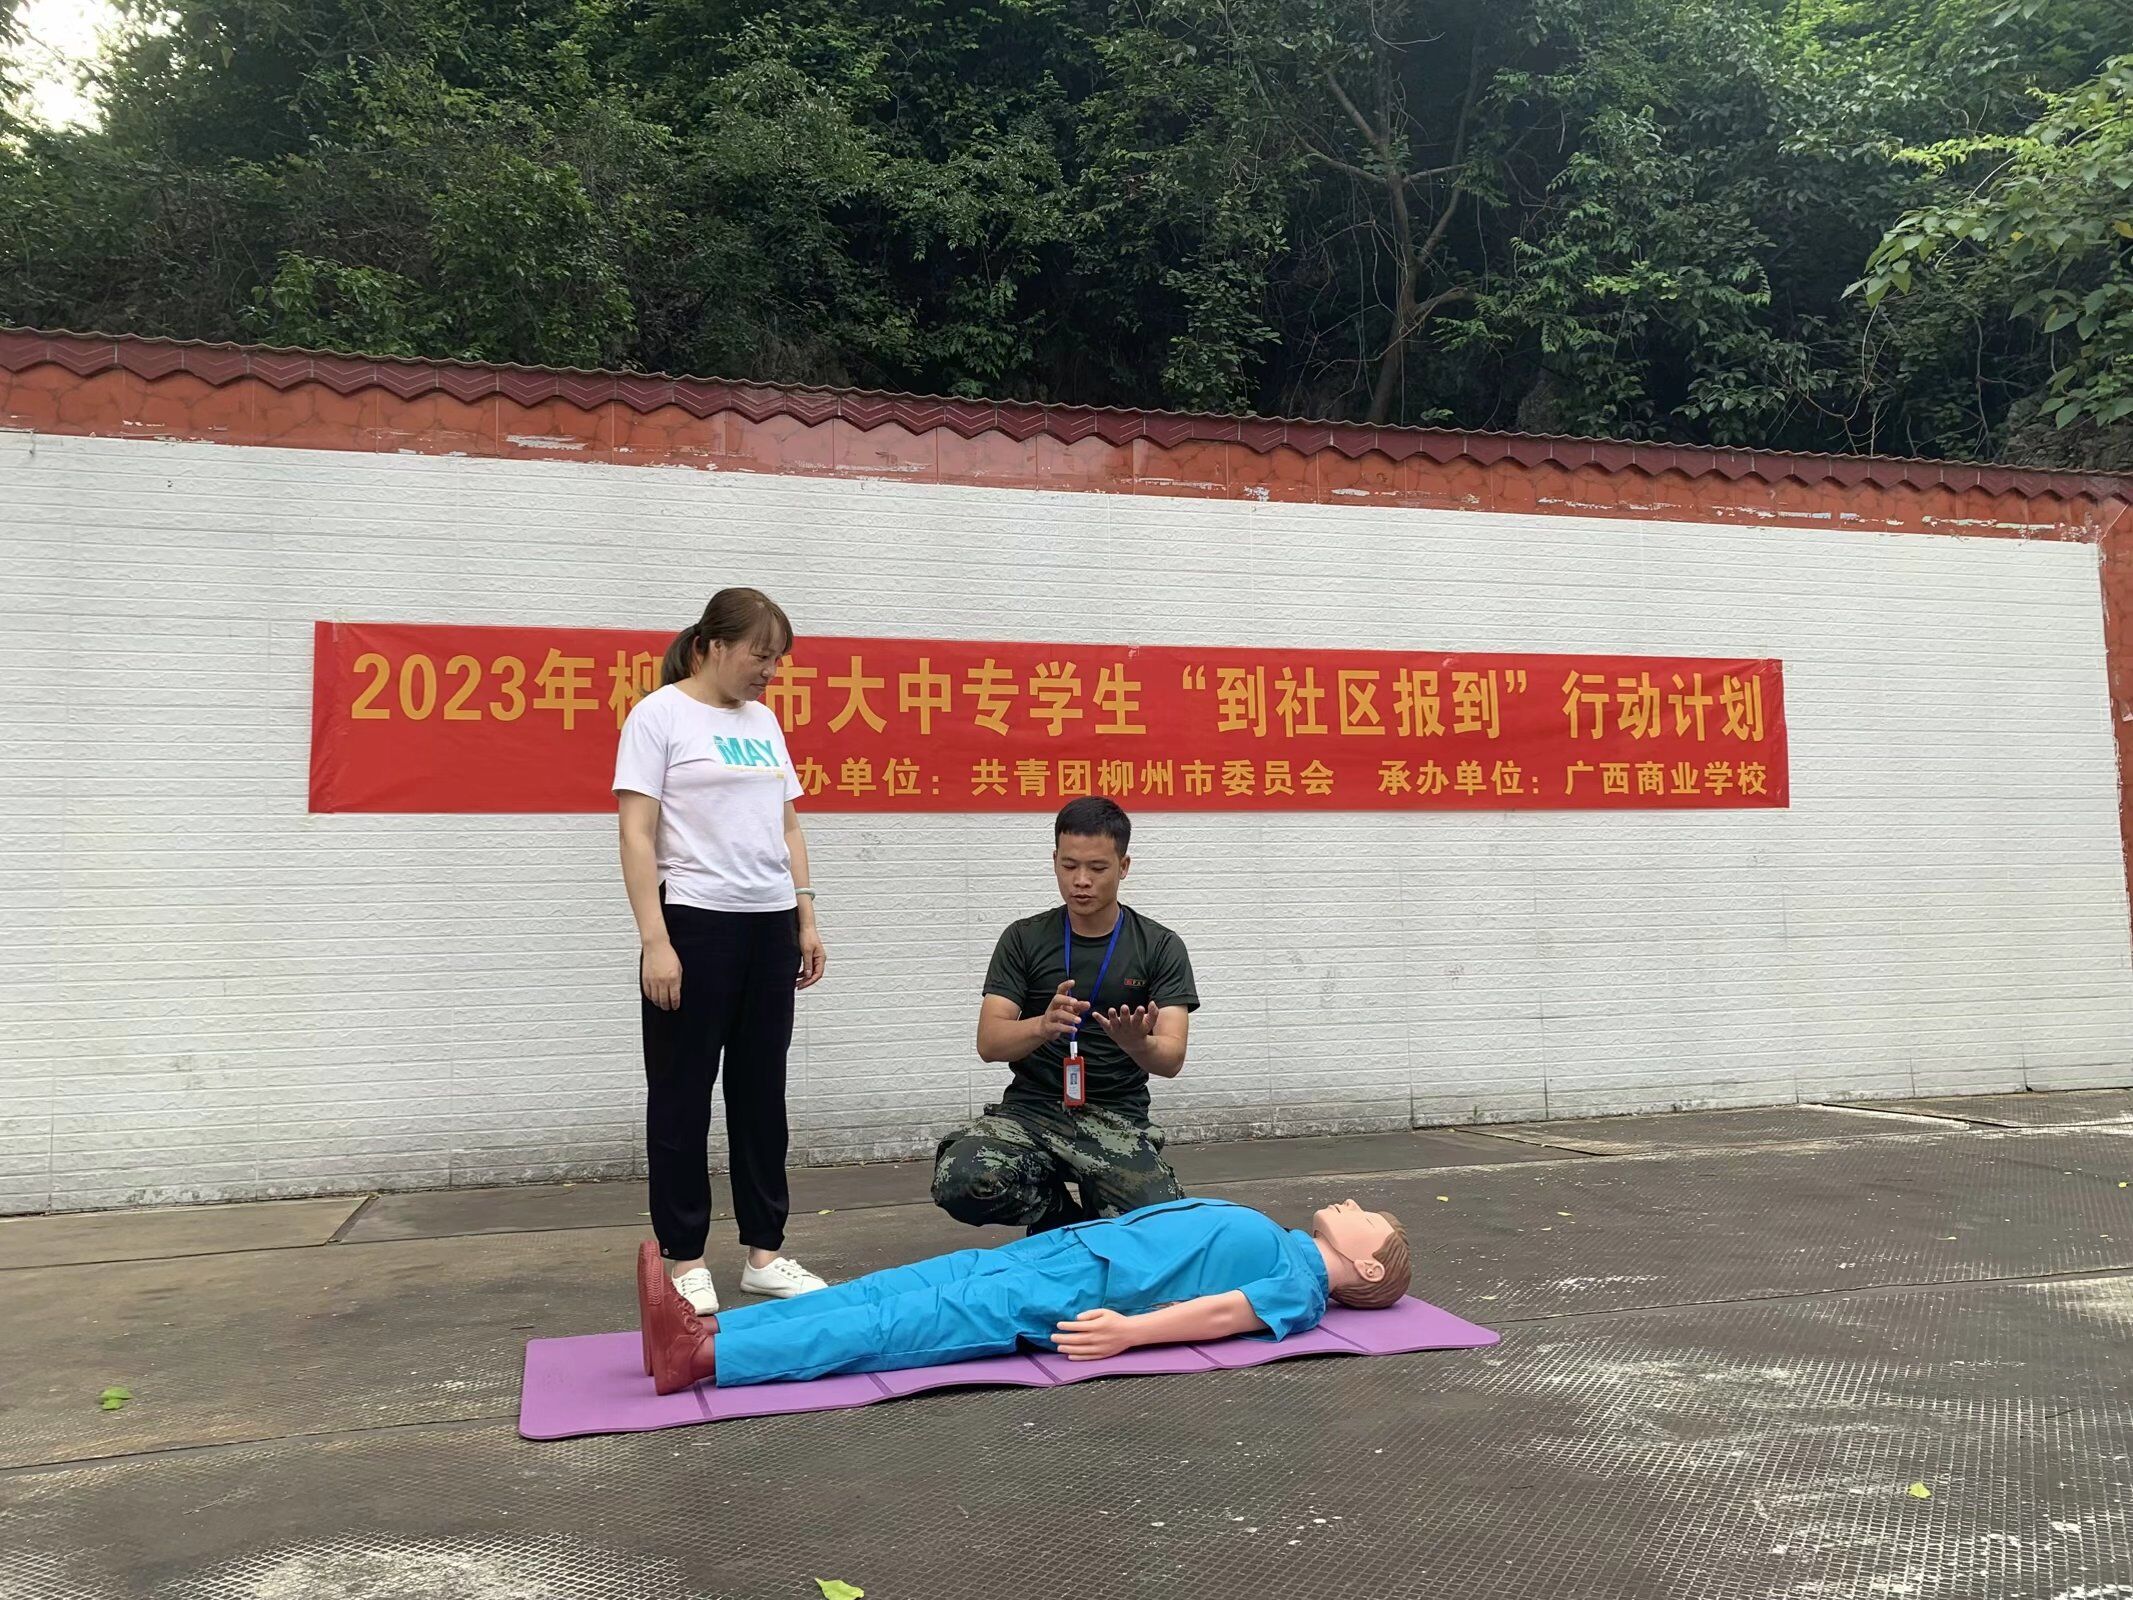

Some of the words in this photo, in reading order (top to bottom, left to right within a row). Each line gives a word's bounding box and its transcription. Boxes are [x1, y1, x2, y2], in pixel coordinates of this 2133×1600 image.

[351, 649, 1147, 738] 2023年柳市大中专学生
[1562, 671, 1765, 742] 行动计划
[797, 757, 941, 796] 办单位：
[971, 759, 1333, 797] 共青团柳州市委员会
[1378, 761, 1541, 797] 承办单位：
[1565, 761, 1767, 797] 广西商业学校
